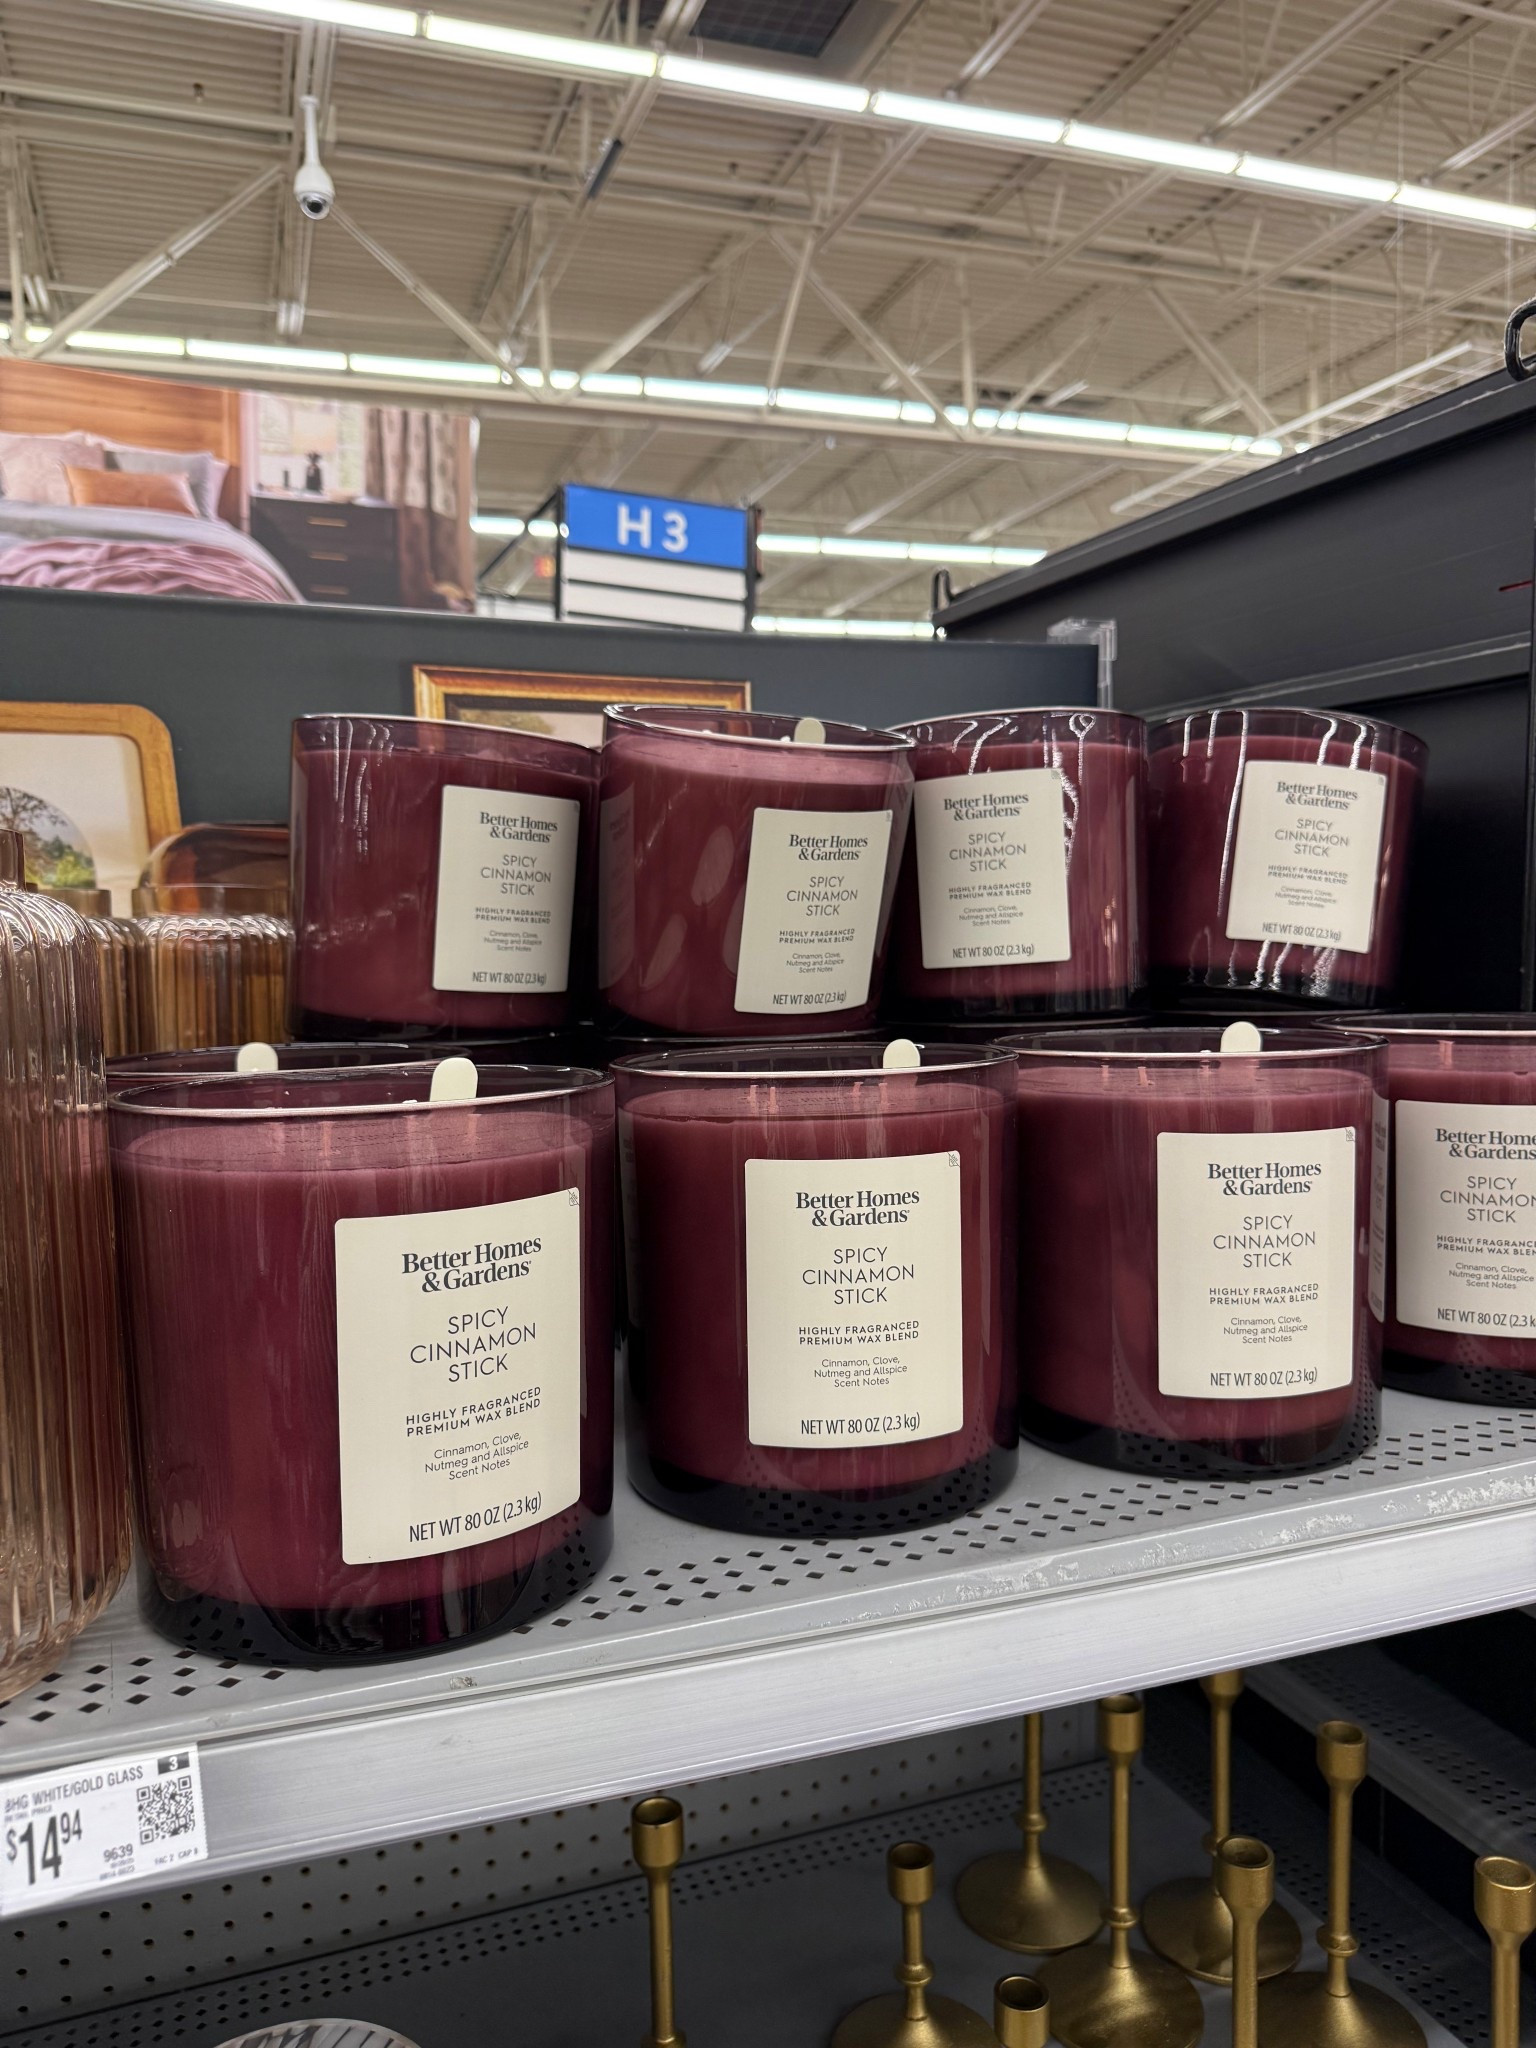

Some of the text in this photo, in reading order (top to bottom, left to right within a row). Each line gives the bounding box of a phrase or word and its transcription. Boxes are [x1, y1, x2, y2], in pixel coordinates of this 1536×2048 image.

[617, 503, 688, 553] H 3
[1276, 781, 1357, 800] Better Homes
[944, 793, 1029, 811] Better Homes
[480, 812, 558, 831] Better Homes
[1296, 819, 1332, 831] SPICY
[789, 834, 868, 848] Better Homes
[968, 832, 1006, 845] SPICY
[1275, 830, 1349, 846] CINNAMON
[811, 849, 860, 860] Gardens
[950, 845, 1026, 860] CINNAMON
[1294, 844, 1329, 857] STICK
[503, 855, 537, 867] SPICY
[970, 859, 1006, 871] STICK
[481, 867, 551, 882] CINNAMON
[501, 883, 535, 895] STICK
[809, 877, 844, 888] SPICY
[786, 890, 858, 902] CINNAMON
[806, 905, 840, 916] STICK
[952, 948, 968, 958] NET
[969, 947, 981, 957] WT
[982, 946, 993, 956] 80
[994, 945, 1005, 956] OZ
[1021, 944, 1034, 956] kg)
[1436, 1128, 1486, 1144] Better
[1208, 1163, 1321, 1179] Better Homes
[1240, 1180, 1311, 1195] Gardens
[1467, 1176, 1517, 1190] SPICY
[796, 1191, 919, 1209] Better Homes
[830, 1209, 908, 1226] Gardens
[1243, 1215, 1292, 1230] SPICY
[1467, 1209, 1516, 1222] STICK
[1213, 1232, 1315, 1249] CINNAMON
[1437, 1235, 1473, 1244] HIGHLY
[402, 1238, 541, 1274] Better Homes
[834, 1247, 887, 1264] SPICY
[1437, 1243, 1483, 1253] PREMIUM
[1487, 1247, 1509, 1255] WAX
[1243, 1252, 1292, 1267] STICK
[444, 1260, 532, 1289] Gardens
[802, 1264, 914, 1284] CINNAMON
[1456, 1263, 1527, 1274] Cinnamon, Clove,
[1449, 1271, 1534, 1282] Nutmeg and Allspice
[1210, 1283, 1319, 1296] HIGHLY FRAGRANCED
[1466, 1280, 1516, 1289] Scent Notes
[834, 1287, 887, 1304] STICK
[1210, 1293, 1318, 1305] PREMIUM WAX BLEND
[448, 1307, 508, 1334] SPICY
[1231, 1316, 1302, 1325] Cinnamon, Clove,
[1438, 1308, 1456, 1320] NET
[1458, 1310, 1475, 1322] WT
[1478, 1311, 1491, 1324] 80
[1493, 1313, 1506, 1326] OZ
[799, 1321, 919, 1335] HIGHLY FRAGRANCED
[1224, 1324, 1307, 1336] Nutmeg and Allspice
[410, 1323, 536, 1364] CINNAMON
[800, 1331, 918, 1345] PREMIUM WAX BLEND
[1242, 1334, 1292, 1344] Scent Notes
[449, 1354, 508, 1382] STICK
[822, 1356, 900, 1368] Cinnamon, Clove,
[814, 1364, 907, 1379] Nutmeg and Allspice
[1211, 1372, 1231, 1386] NET
[1234, 1372, 1251, 1386] WT
[1254, 1372, 1267, 1386] 80
[1270, 1372, 1282, 1385] OZ
[1303, 1367, 1317, 1384] kg)
[834, 1377, 889, 1388] Scent Notes
[406, 1387, 541, 1425] HIGHLY FRAGRANCED
[407, 1399, 541, 1437] PREMIUM WAX BLEND
[802, 1420, 823, 1434] NET
[826, 1420, 844, 1434] WT
[848, 1419, 862, 1433] 80
[865, 1418, 880, 1432] OZ
[904, 1412, 920, 1431] kg)
[434, 1431, 521, 1459] Cinnamon, Clove,
[425, 1439, 529, 1472] Nutmeg and Allspice
[449, 1458, 510, 1480] Scent Notes
[409, 1522, 436, 1542] NET
[439, 1516, 462, 1536] WT
[465, 1512, 481, 1531] 80
[484, 1507, 501, 1526] OZ
[525, 1491, 541, 1513] kg)
[169, 1757, 178, 1770] 3
[32, 1776, 103, 1805] WHITE/GOLD
[108, 1766, 143, 1786] GLASS
[104, 1844, 133, 1862] 9639
